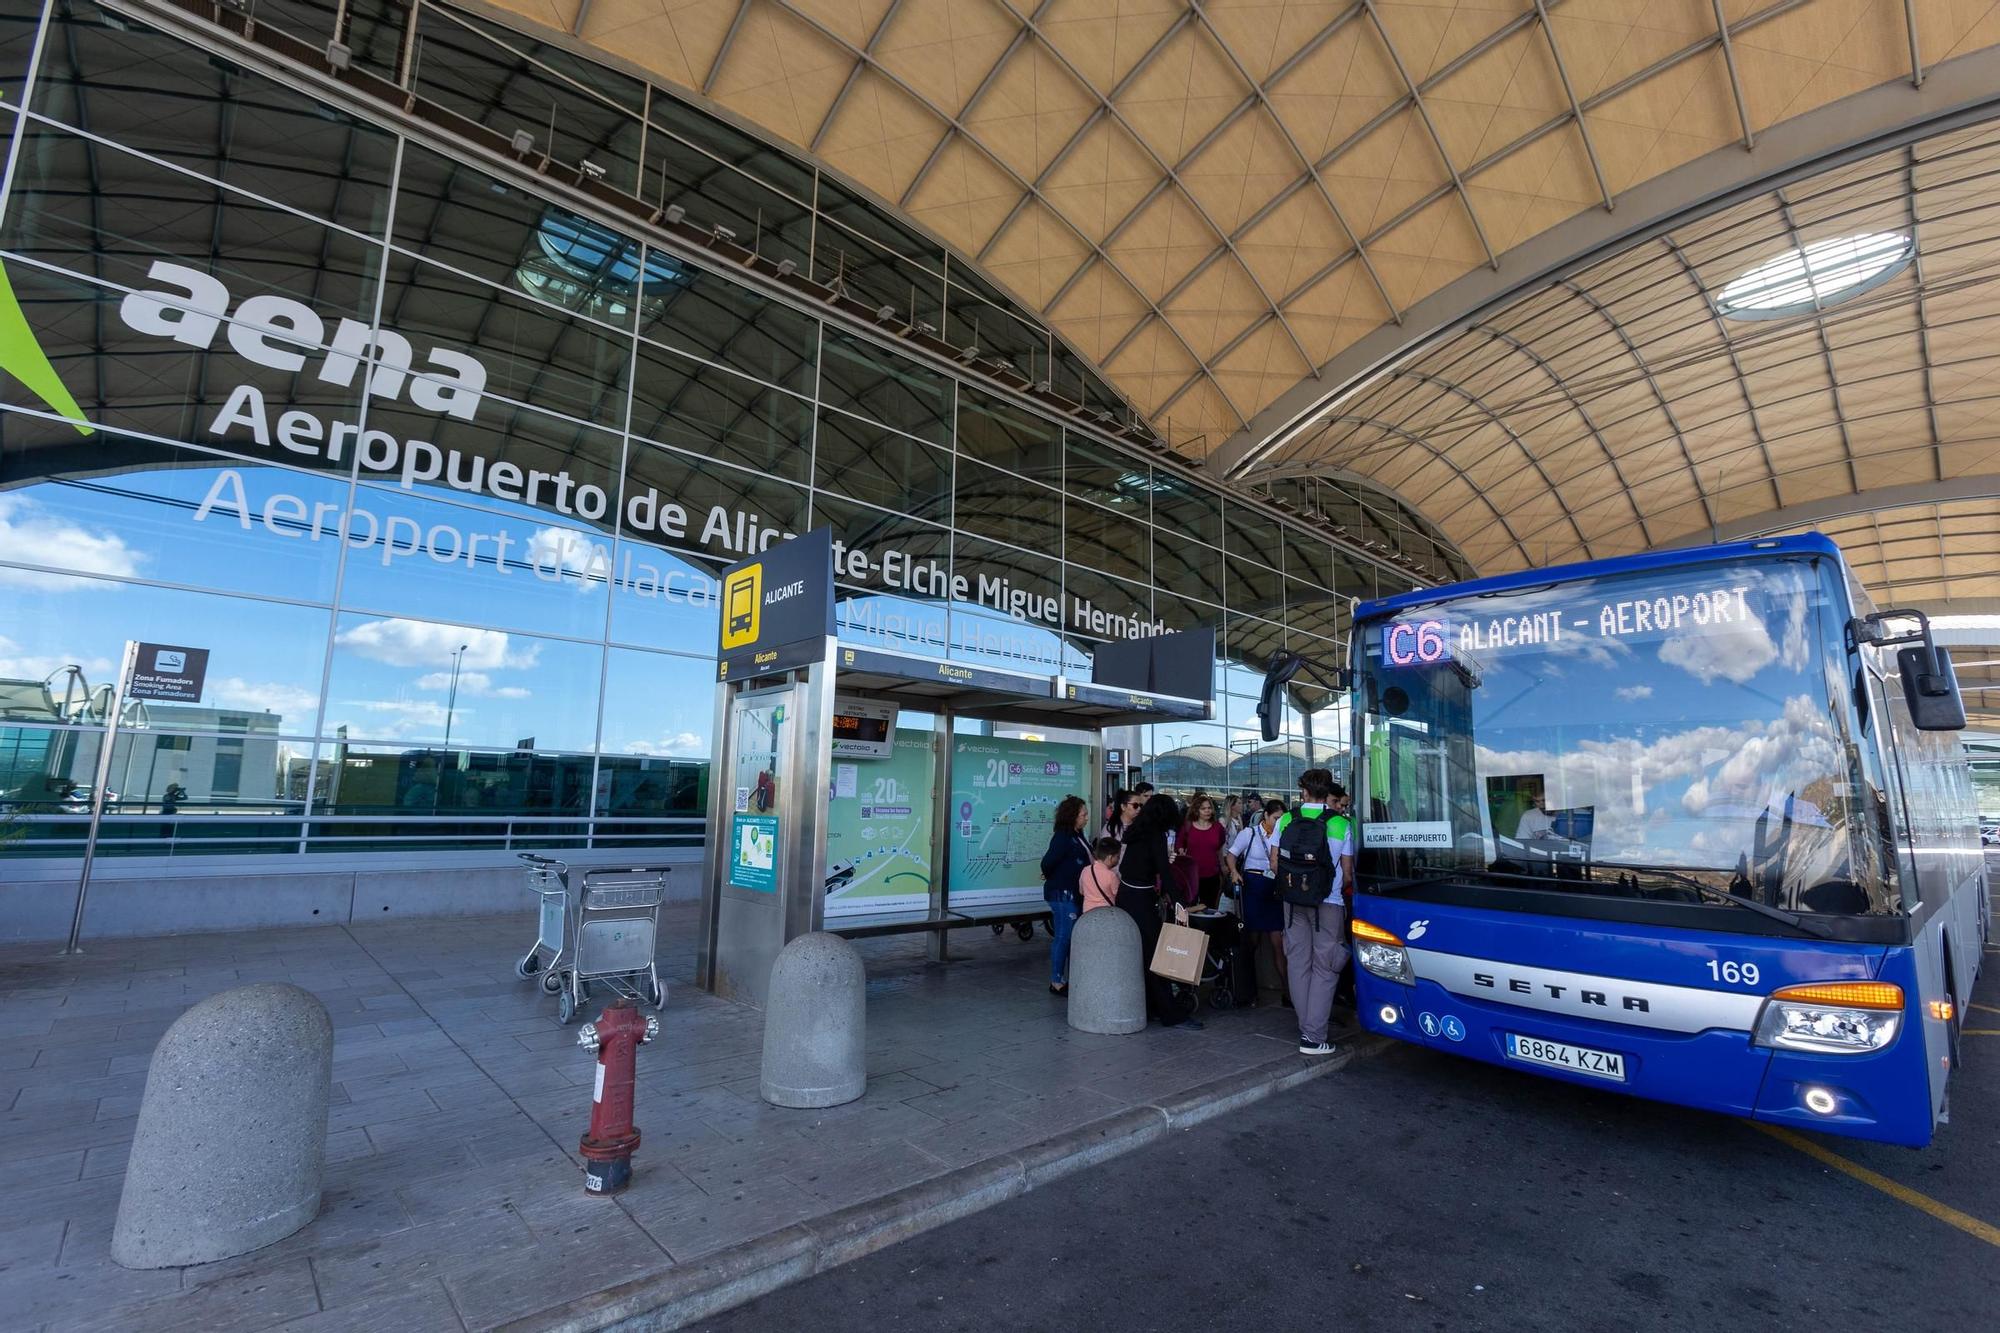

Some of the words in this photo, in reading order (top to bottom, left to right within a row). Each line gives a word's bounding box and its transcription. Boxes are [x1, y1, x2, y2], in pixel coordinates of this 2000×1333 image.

[119, 259, 488, 421] aena
[209, 384, 606, 521] Aeropuerto
[627, 488, 688, 538] de
[700, 505, 969, 602] Alicte-Elche
[978, 573, 1065, 622] Miguel
[1074, 597, 1184, 641] Hernánd
[193, 469, 516, 577] Aeroport
[844, 596, 950, 650] Miguel
[764, 580, 804, 606] ALICANTE
[1388, 620, 1444, 665] C6
[1459, 611, 1562, 651] ALACANT
[1600, 586, 1749, 637] AEROPORT
[754, 650, 778, 665] Alicante
[156, 675, 194, 685] Fumadors
[938, 664, 973, 679] Alicante
[132, 687, 152, 695] Zona
[153, 689, 196, 698] Fumadores
[133, 681, 164, 690] Smoking
[986, 758, 1009, 788] 20
[874, 777, 897, 804] 20
[1366, 833, 1394, 843] ALICANTE
[1400, 833, 1447, 842] AEROPUERTO
[1706, 959, 1760, 987] 169
[1474, 972, 1651, 1014] SETRA
[1519, 1038, 1571, 1065] 6864
[1577, 1051, 1620, 1075] KZM
